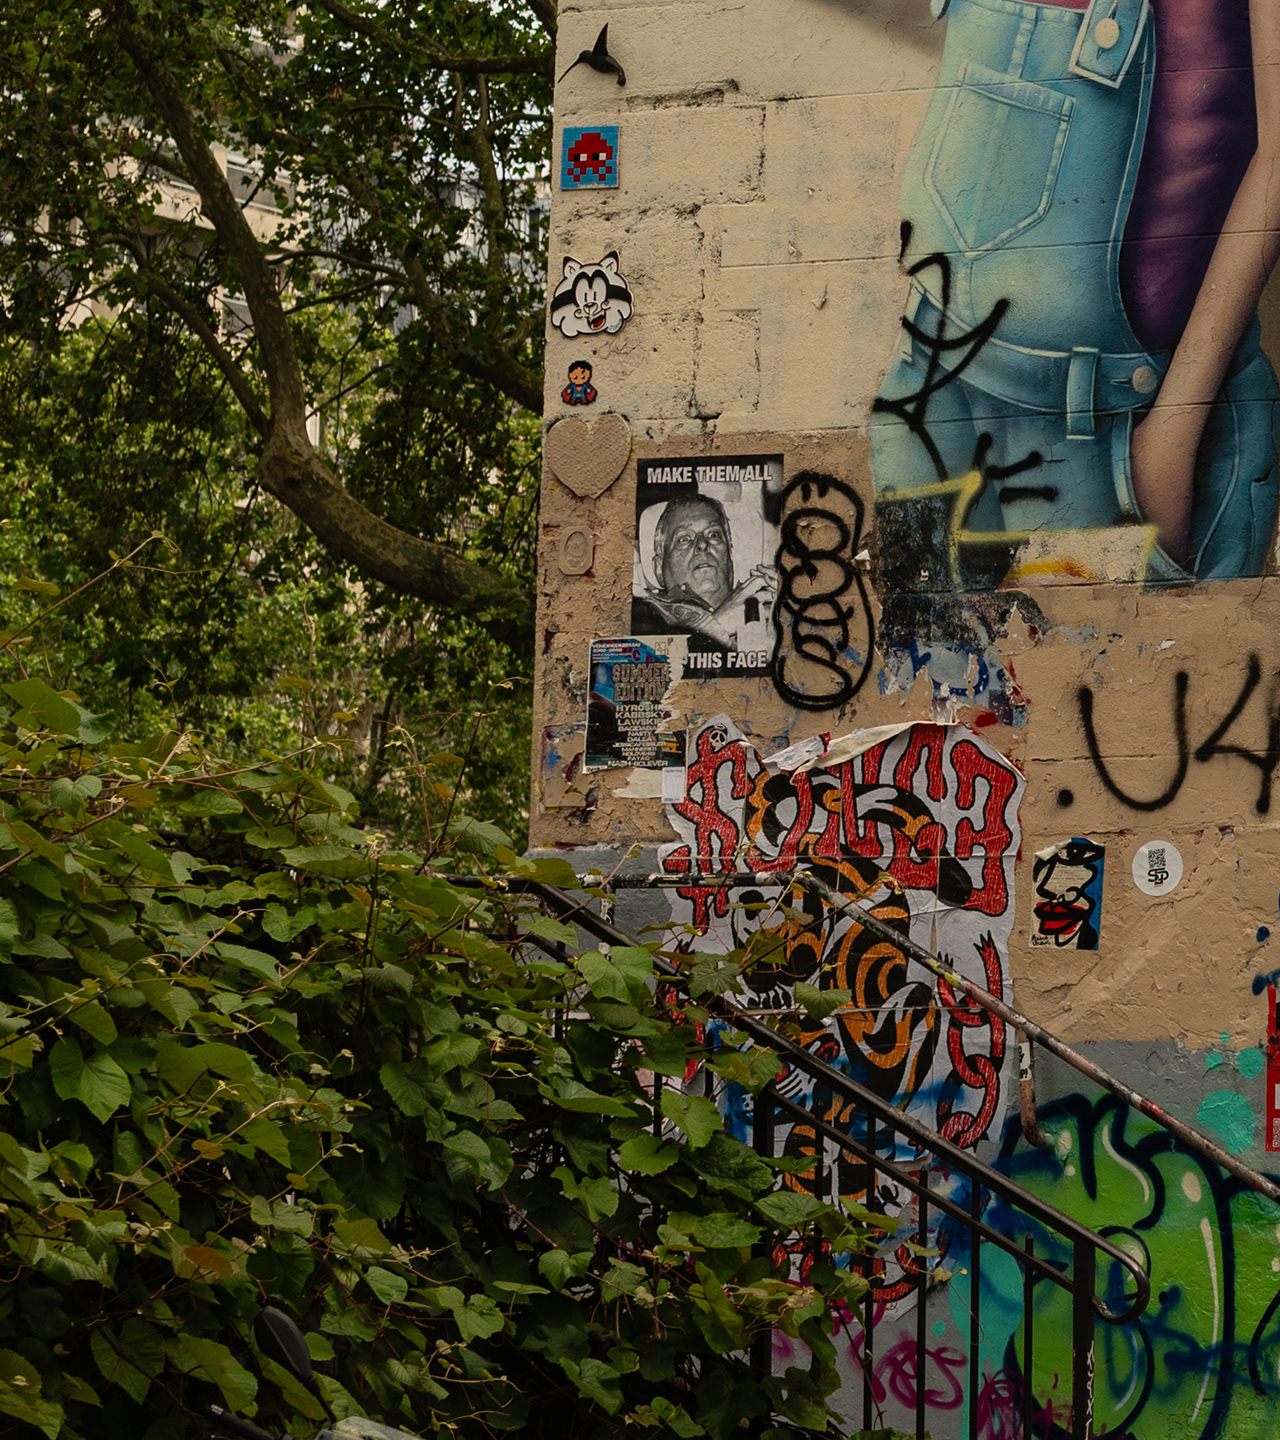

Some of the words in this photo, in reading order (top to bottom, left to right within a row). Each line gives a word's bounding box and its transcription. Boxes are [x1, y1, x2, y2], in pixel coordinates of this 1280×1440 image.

[647, 467, 692, 484] MAKE
[696, 465, 740, 482] THEM
[744, 464, 773, 481] ALL
[688, 652, 722, 669] THIS
[726, 651, 767, 668] FACE
[612, 663, 669, 683] SUMMER
[613, 681, 667, 702] EDITION
